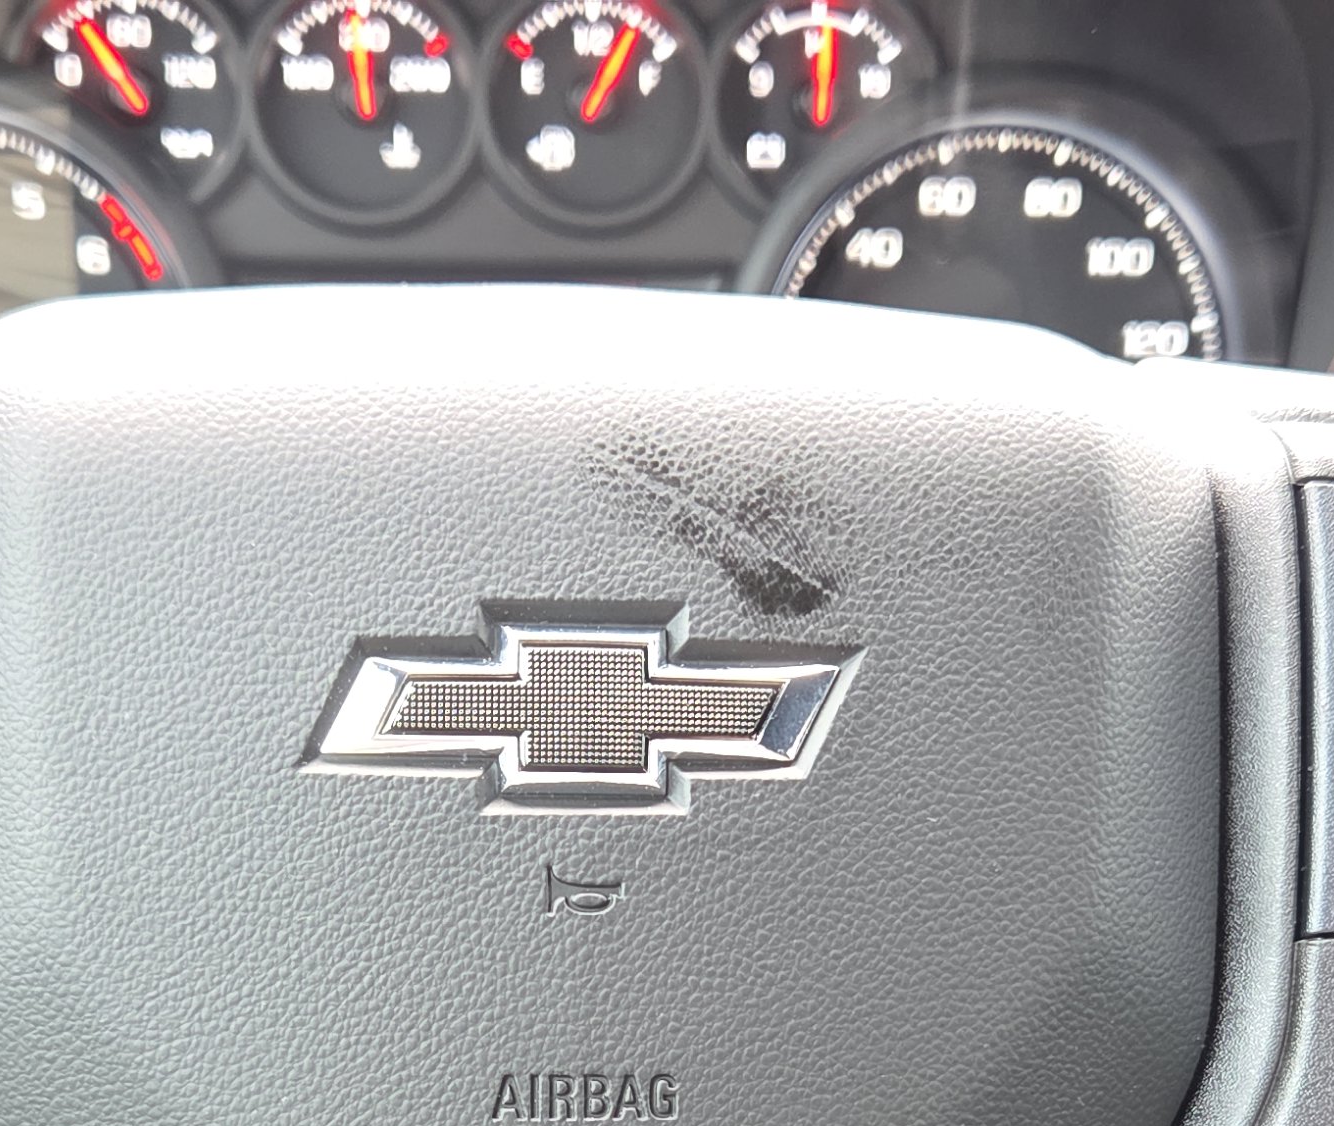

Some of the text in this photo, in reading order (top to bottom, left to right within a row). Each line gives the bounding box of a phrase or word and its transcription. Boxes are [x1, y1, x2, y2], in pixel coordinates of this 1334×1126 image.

[11, 181, 46, 220] 5
[918, 176, 976, 217] 60
[1023, 178, 1082, 218] 80
[77, 235, 111, 276] 6
[846, 228, 903, 268] 40
[1087, 238, 1154, 276] 100
[1122, 320, 1188, 358] 120
[491, 1073, 681, 1122] AIRBAG
